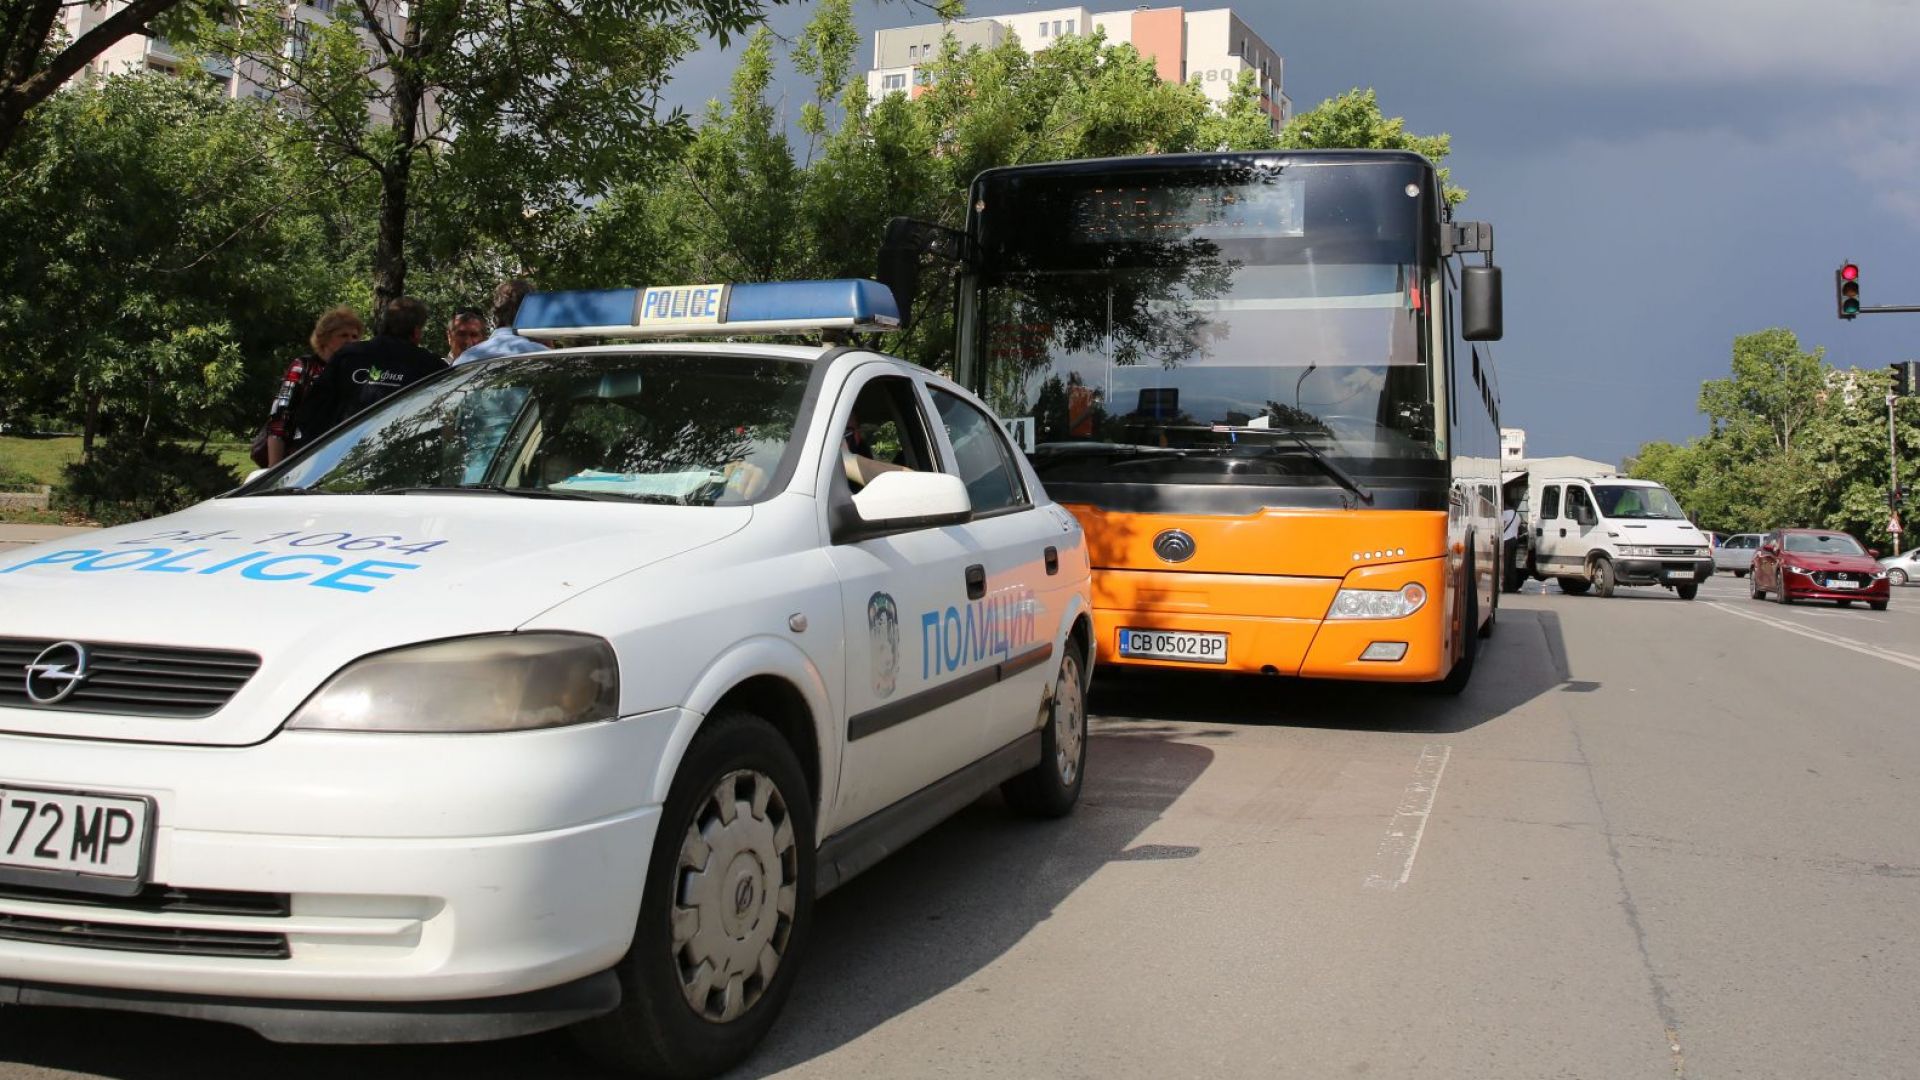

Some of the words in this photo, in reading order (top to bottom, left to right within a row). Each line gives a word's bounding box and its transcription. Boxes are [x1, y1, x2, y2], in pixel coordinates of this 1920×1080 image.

[643, 288, 719, 318] POLICE
[0, 547, 422, 593] POLICE
[921, 590, 1036, 681] ПОЛИЦИЯ
[1156, 635, 1197, 654] 0502
[0, 798, 64, 860] 72
[70, 804, 134, 864] MP
